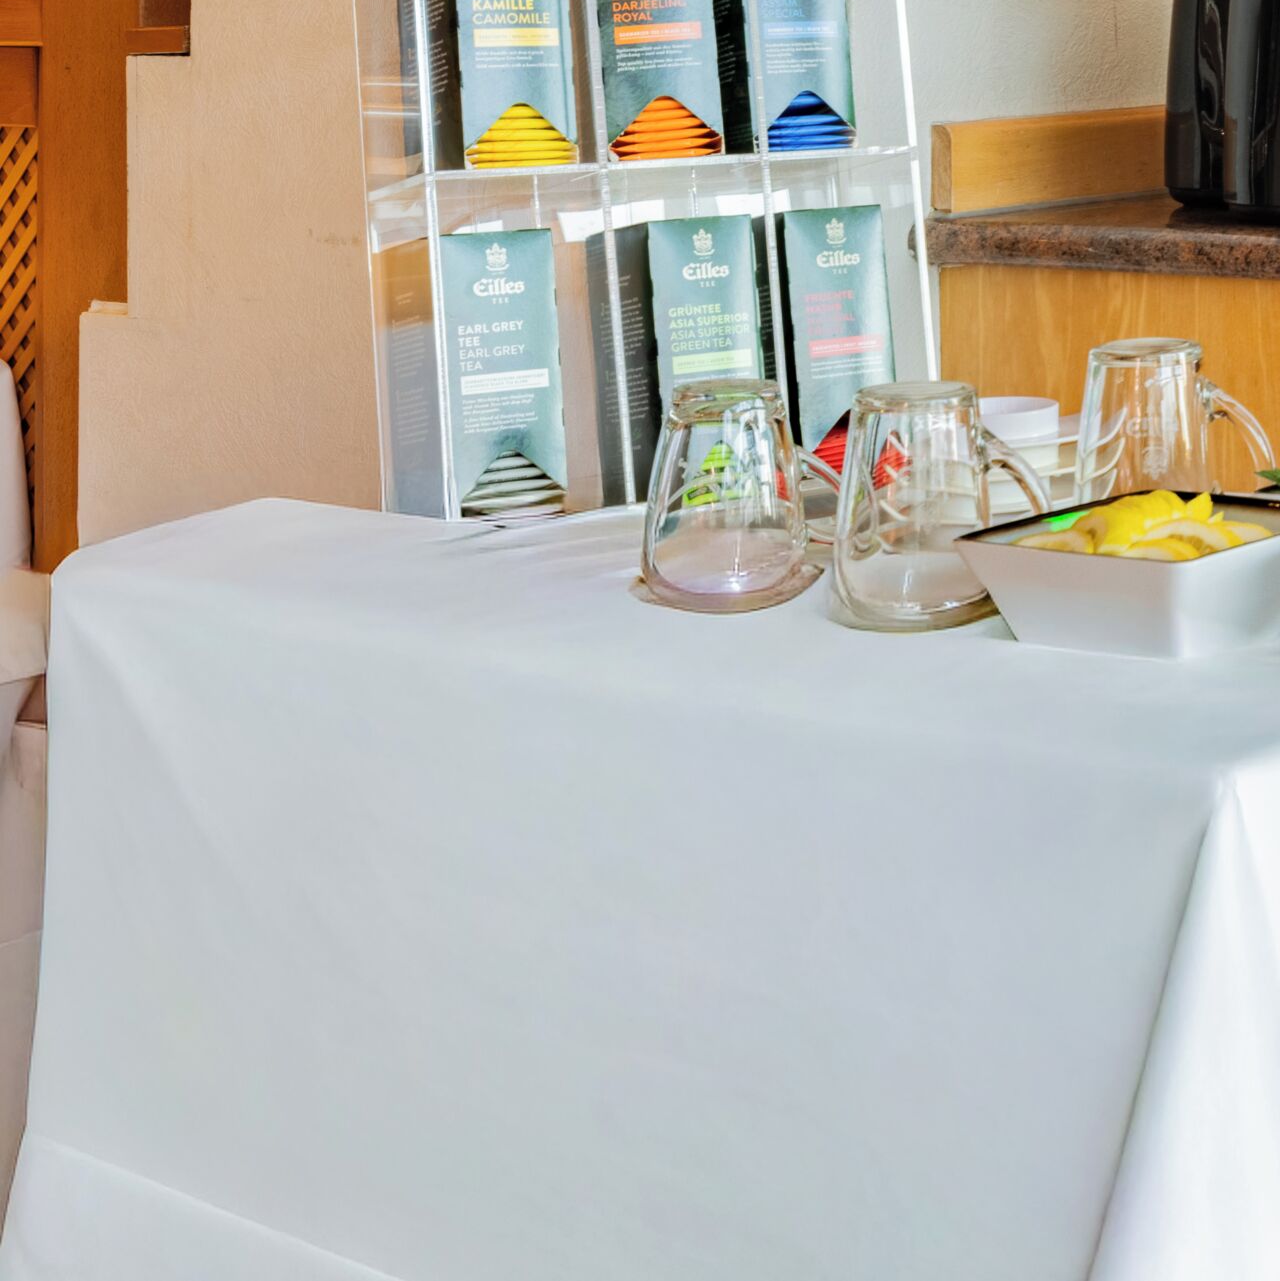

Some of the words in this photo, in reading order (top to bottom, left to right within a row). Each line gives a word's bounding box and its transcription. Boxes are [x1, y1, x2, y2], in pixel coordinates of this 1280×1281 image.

[612, 0, 687, 12] DARJEELING
[472, 12, 551, 25] CAMOMILE
[613, 12, 654, 23] ROYAL
[816, 250, 860, 268] Eilles
[682, 261, 730, 280] Eilles
[473, 277, 525, 297] Eilles
[492, 297, 510, 305] TEE
[668, 303, 721, 318] GRÜNTEE
[457, 324, 490, 336] EARL
[491, 320, 524, 333] GREY
[669, 317, 695, 329] ASIA
[697, 312, 750, 327] SUPERIOR
[670, 329, 696, 341] ASIA
[698, 323, 751, 338] SUPERIOR
[458, 336, 481, 348] TEE
[671, 340, 710, 352] GREEN
[713, 337, 733, 348] TEA
[459, 348, 490, 360] EARL
[493, 344, 525, 357] GREY
[459, 361, 484, 372] TEA
